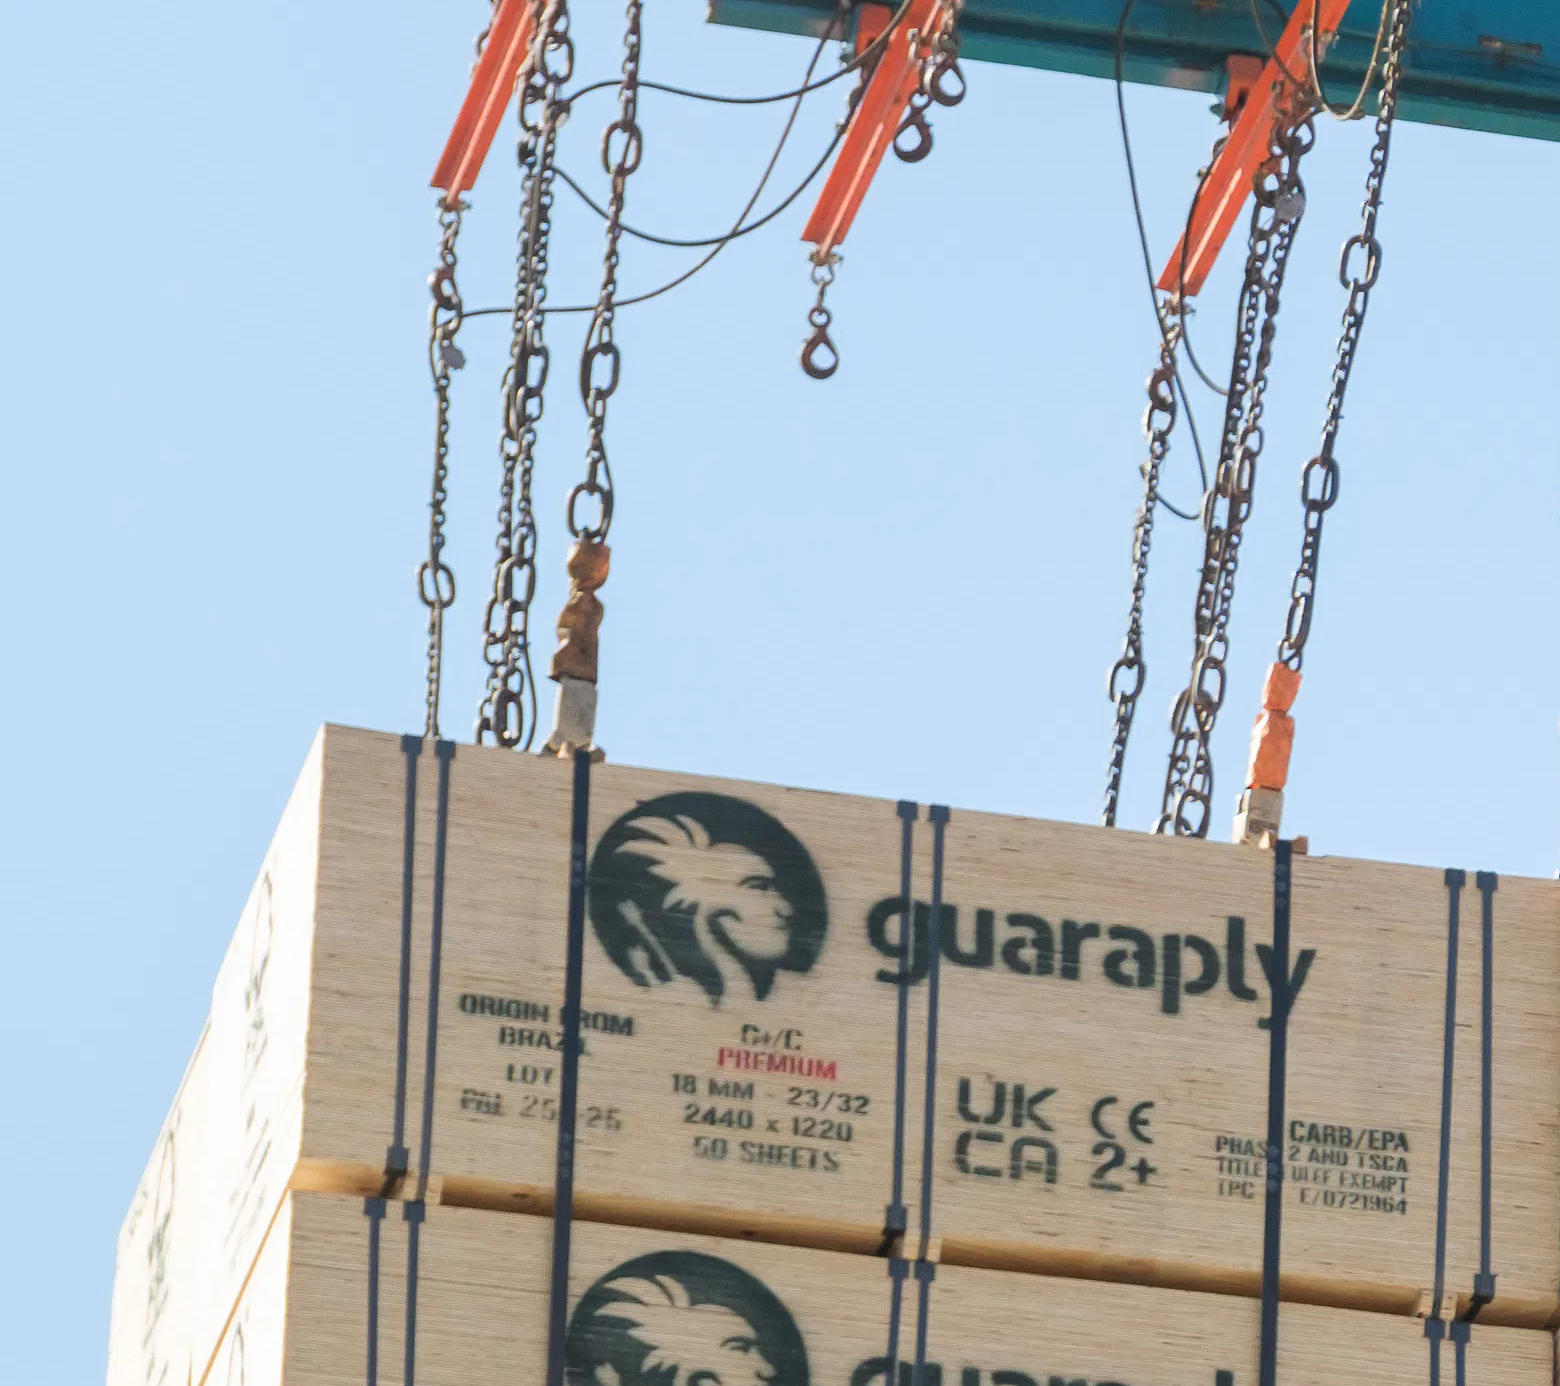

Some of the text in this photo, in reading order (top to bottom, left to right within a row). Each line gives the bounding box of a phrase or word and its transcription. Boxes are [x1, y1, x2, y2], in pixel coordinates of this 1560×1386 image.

[867, 895, 1317, 1030] guaraply
[717, 1046, 838, 1082] PREMIUM
[670, 1073, 870, 1115] 18 MM 23/32
[956, 1077, 1056, 1131] UK
[683, 1104, 852, 1142] 2440 1220
[1289, 1120, 1409, 1152] CARB/EPA
[954, 1130, 1157, 1192] CA 2+
